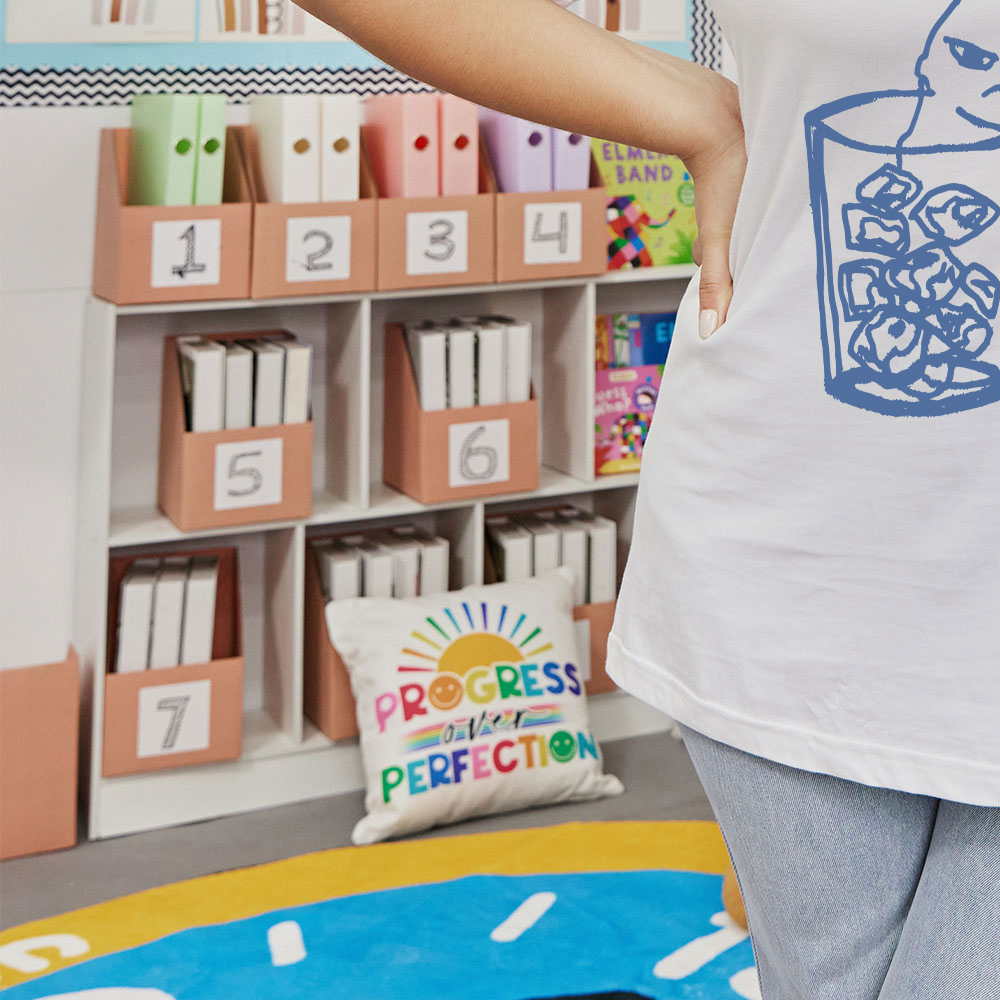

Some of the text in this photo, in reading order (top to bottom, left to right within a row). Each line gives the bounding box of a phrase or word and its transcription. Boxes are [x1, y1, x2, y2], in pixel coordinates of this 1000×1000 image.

[615, 164, 673, 184] BAND
[172, 224, 206, 278] 1
[303, 229, 334, 271] 2
[424, 219, 455, 262] 3
[531, 211, 568, 254] 4
[226, 450, 264, 497] 5
[460, 425, 498, 481] 6
[374, 661, 582, 734] PROGRESS
[155, 695, 191, 750] 7
[442, 708, 530, 745] over
[381, 729, 599, 804] PERFECTION
